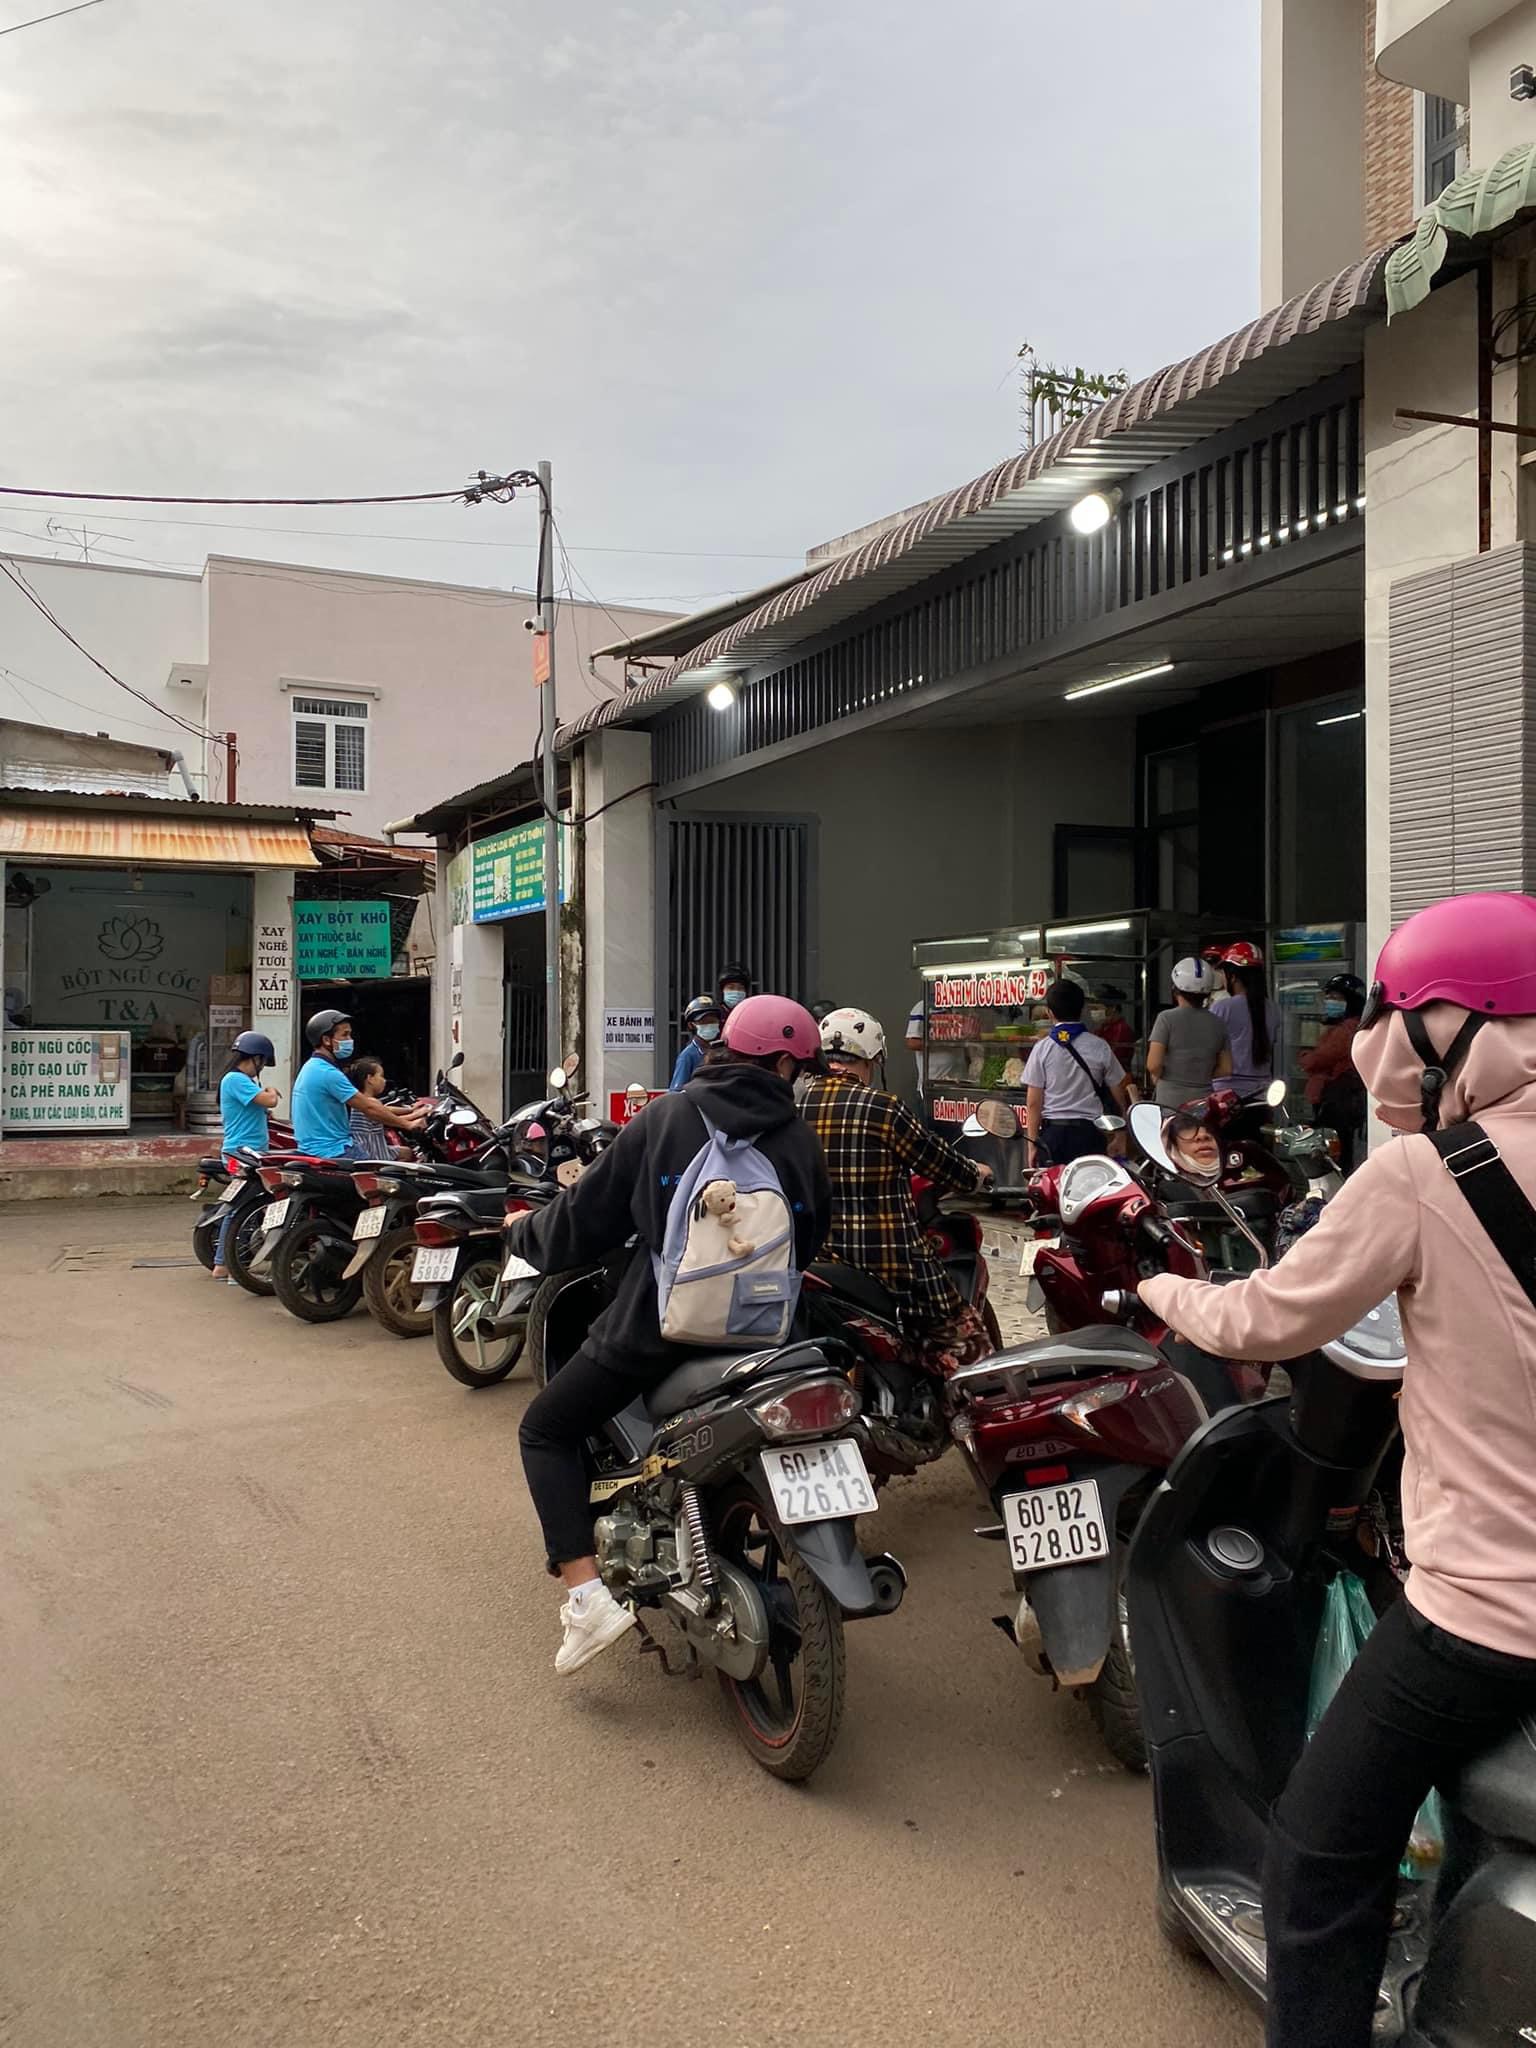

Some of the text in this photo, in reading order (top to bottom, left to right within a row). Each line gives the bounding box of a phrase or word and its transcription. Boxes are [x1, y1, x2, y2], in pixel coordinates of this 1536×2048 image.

[297, 909, 388, 927] XAY BỘT KHÔ
[261, 926, 286, 937] XAY
[298, 933, 314, 943] XAY
[258, 955, 286, 967] TƯƠI
[298, 949, 314, 959] XAY
[61, 964, 200, 993] BỘT NGŨ CỐC
[935, 974, 964, 1007] BÁNH
[964, 971, 977, 1007] MÌ
[977, 970, 993, 1007] CÔ
[1029, 969, 1048, 999] 52
[98, 999, 160, 1021] T&A
[606, 1016, 617, 1027] XE
[619, 1014, 642, 1027] BÁNH
[11, 1036, 92, 1057] BỘT NGŨ CỐC
[11, 1060, 88, 1078] BỘT GẠO LỨT
[11, 1082, 116, 1098] CÀ PHÊ RANG XAY
[33, 1106, 46, 1120] XAY
[934, 1095, 956, 1121] BÁNH
[416, 1265, 448, 1281] 5882
[780, 1447, 850, 1484] 60-AA
[780, 1477, 870, 1519] 226.13
[1017, 1487, 1086, 1528] 60-B2
[1012, 1521, 1102, 1566] 528.09
